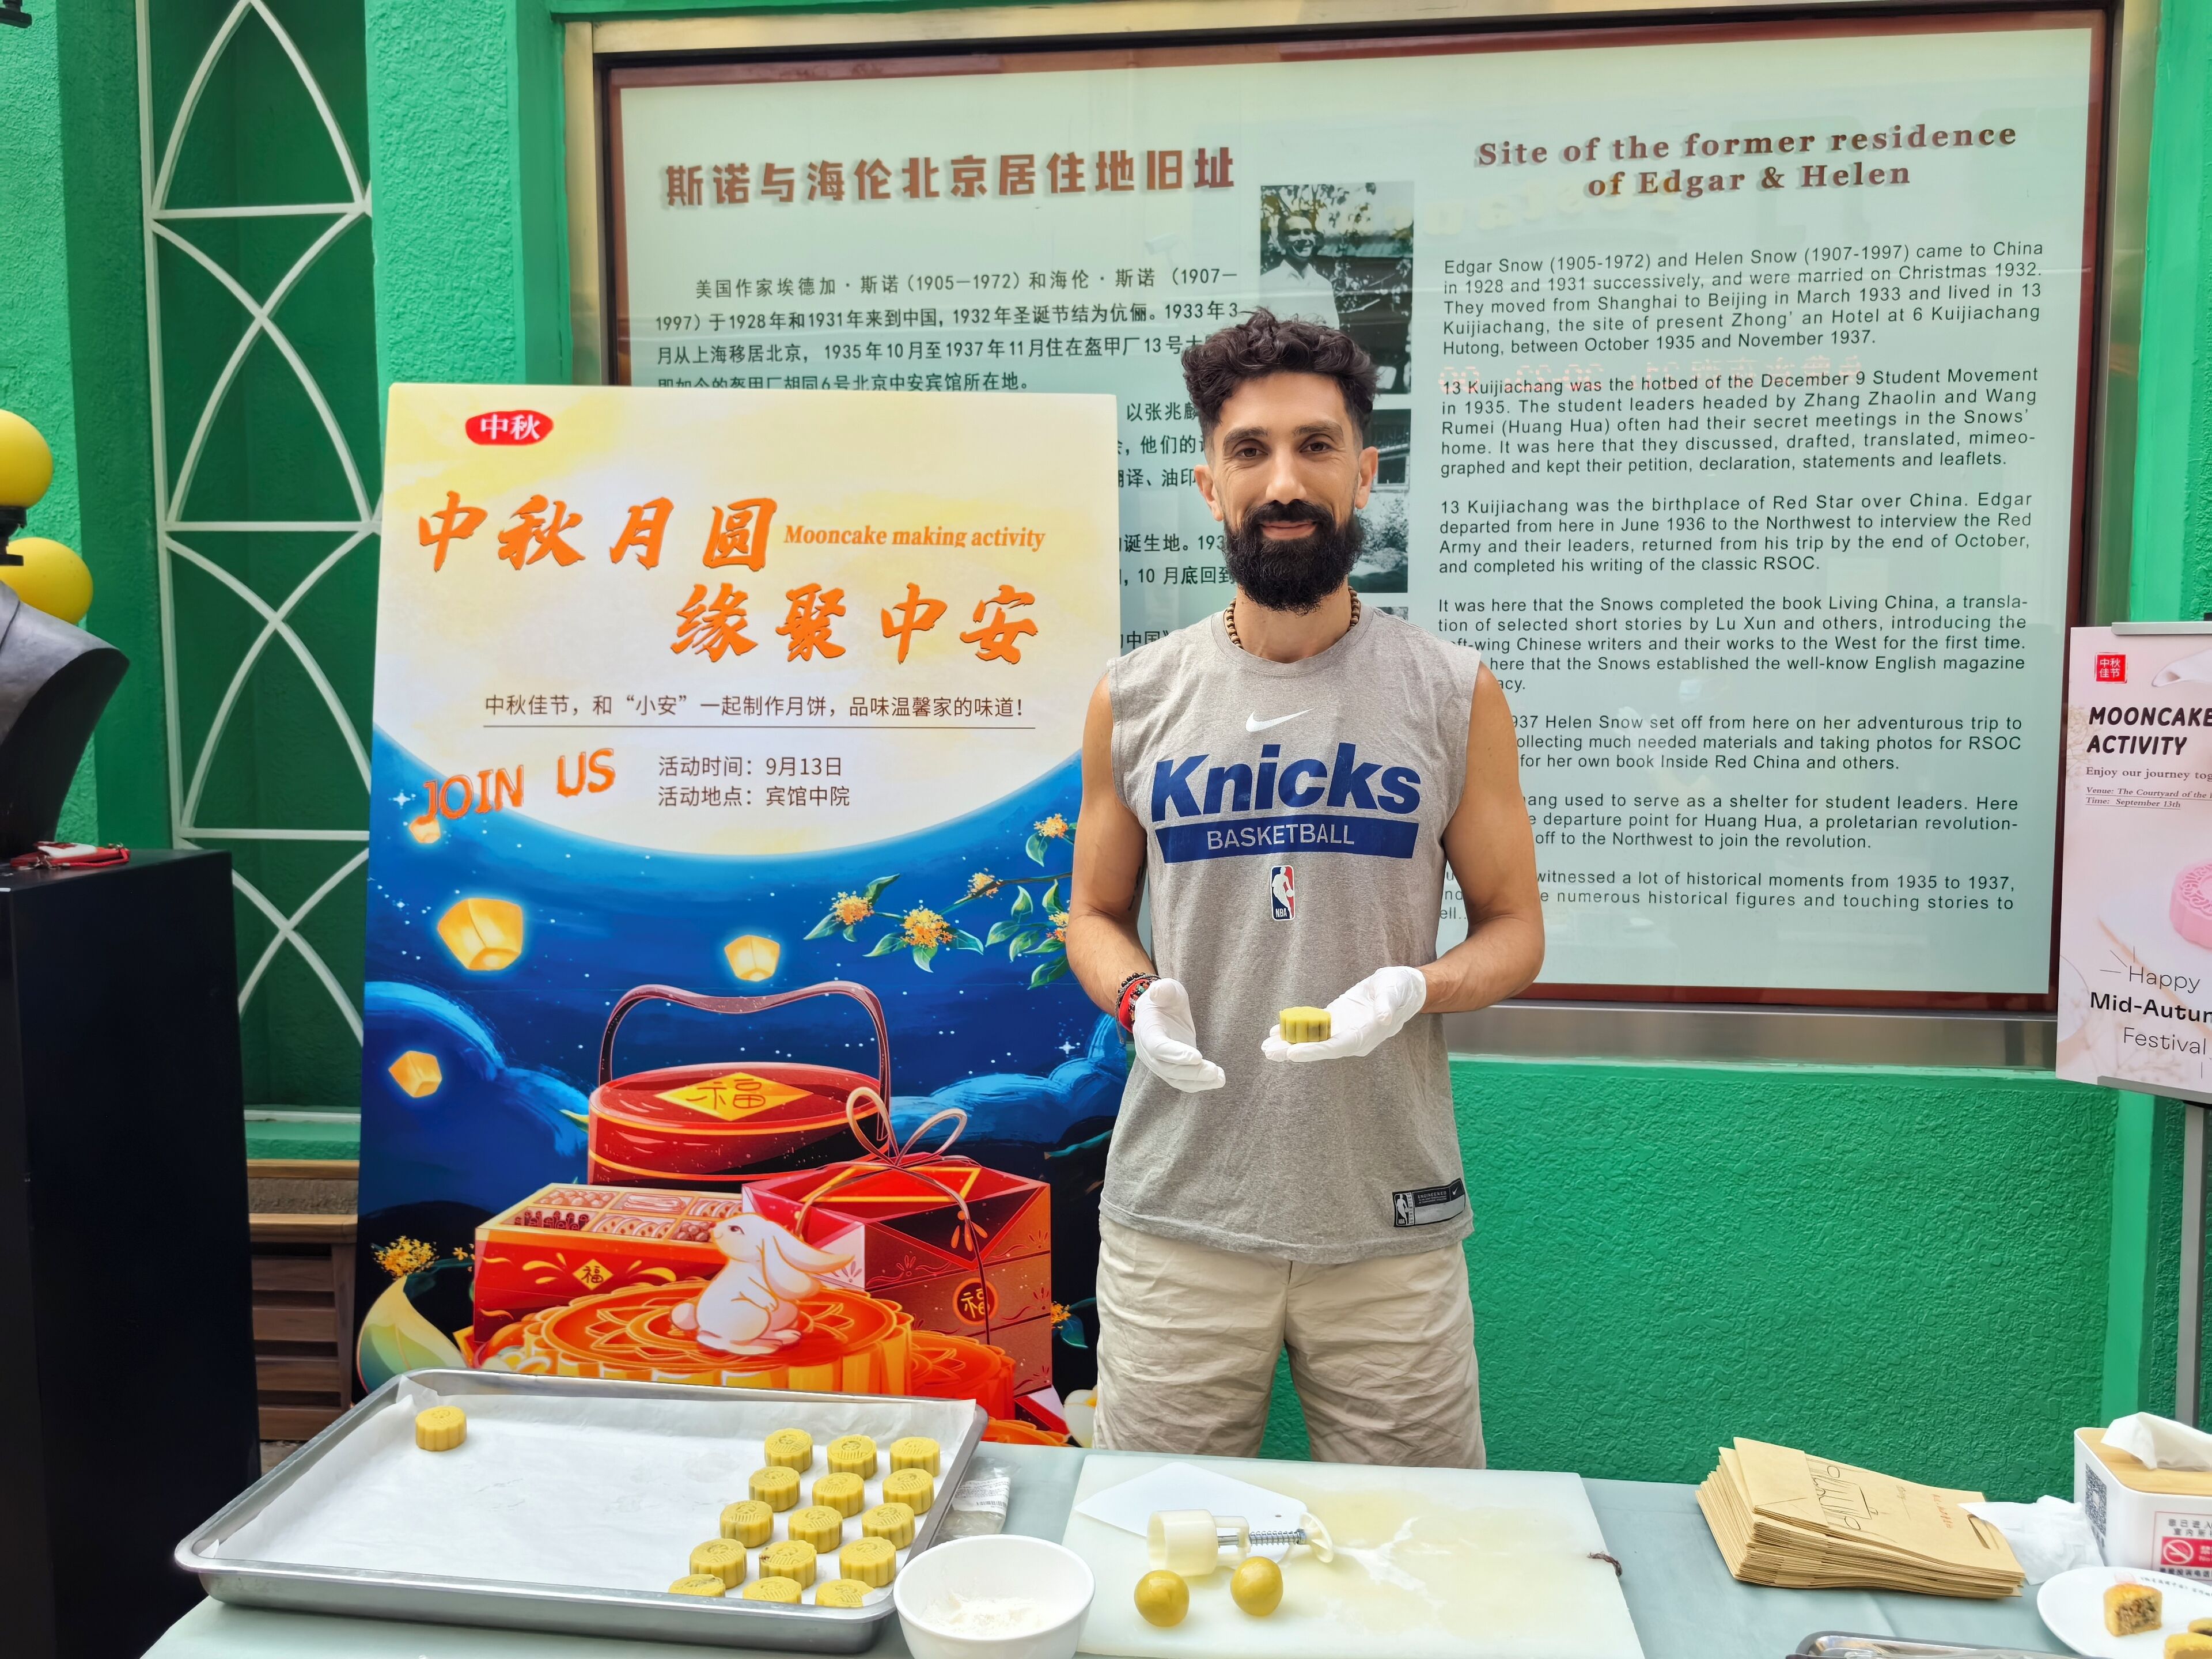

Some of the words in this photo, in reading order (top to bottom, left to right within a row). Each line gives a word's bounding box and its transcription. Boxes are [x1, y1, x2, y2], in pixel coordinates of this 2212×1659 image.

[1478, 141, 1548, 165] Site
[1563, 137, 1600, 161] of
[1612, 135, 1669, 160] the
[1685, 133, 1815, 157] former
[1831, 124, 2016, 151] residence
[666, 147, 1234, 206] 斯诺与海伦北京居住地旧址
[1588, 172, 1625, 196] of
[1638, 169, 1745, 198] Edgar
[1761, 166, 1785, 189] &
[1801, 162, 1910, 187] Helen
[1445, 260, 1492, 276] Edgar
[1499, 259, 1543, 272] Snow
[1551, 253, 1650, 274] (1905-1972)
[1658, 252, 1687, 267] and
[1695, 251, 1743, 266] Helen
[1751, 249, 1797, 264] Snow
[1805, 244, 1908, 266] (1907-1997)
[1916, 247, 1962, 258] came
[1971, 243, 1985, 256] to
[1994, 241, 2042, 256] China
[1444, 320, 1549, 338] Kuijiachang,
[1559, 318, 1584, 331] the
[1593, 317, 1623, 331] site
[1633, 316, 1649, 329] of
[1657, 314, 1723, 332] present
[1802, 314, 1822, 324] an
[1832, 308, 1878, 323] Hotel
[1888, 308, 1904, 321] at
[1914, 307, 1922, 321] 6
[1932, 305, 2039, 323] Kuijiachang
[1444, 381, 1461, 395] 13
[1468, 380, 1562, 397] Kuijiachang
[1570, 381, 1601, 392] was
[1609, 377, 1633, 391] the
[1642, 376, 1698, 391] hotbed
[1706, 375, 1722, 389] of
[1728, 375, 1753, 388] the
[1762, 372, 1849, 387] December
[1856, 371, 1865, 385] 9
[1873, 370, 1940, 384] Student
[1948, 368, 2037, 382] Movement
[480, 414, 540, 442] 中秋
[1442, 441, 1491, 454] home.
[1501, 441, 1509, 453] It
[1517, 443, 1549, 453] was
[1558, 440, 1594, 452] here
[1603, 438, 1634, 452] that
[1642, 438, 1677, 454] they
[1686, 435, 1778, 450] discussed,
[1787, 433, 1855, 449] drafted,
[1864, 431, 1960, 446] translated,
[1969, 430, 2035, 444] mimeo-
[1442, 501, 1459, 514] 13
[1468, 499, 1567, 517] Kuijiachang
[1577, 502, 1609, 512] was
[1618, 498, 1643, 512] the
[1653, 497, 1740, 513] birthplace
[1748, 495, 1765, 510] of
[1774, 495, 1807, 509] Red
[1816, 495, 1853, 509] Star
[1862, 497, 1901, 508] over
[1910, 493, 1967, 507] China.
[1978, 492, 2032, 509] Edgar
[418, 490, 778, 573] 中秋月圆
[783, 525, 887, 545] Mooncake
[892, 527, 967, 548] making
[971, 527, 1046, 552] activity
[1119, 533, 1224, 552] 诞生地。193
[671, 582, 1039, 665] 缘聚中安
[1438, 619, 1467, 631] tion
[1476, 618, 1491, 631] of
[1498, 618, 1567, 631] selected
[1575, 618, 1617, 631] short
[1626, 617, 1681, 630] stories
[1690, 617, 1709, 634] by
[1717, 616, 1735, 630] Lu
[1744, 616, 1775, 630] Xun
[1784, 616, 1814, 630] and
[1823, 616, 1883, 631] others,
[1892, 615, 1990, 632] introducing
[1999, 615, 2026, 628] the
[1490, 657, 1524, 670] here
[1531, 657, 1560, 670] that
[1567, 657, 1591, 670] the
[1598, 657, 1650, 670] Snows
[1657, 657, 1748, 670] established
[1756, 657, 1780, 669] the
[1787, 656, 1868, 669] well-know
[1876, 656, 1936, 673] English
[1944, 656, 2024, 673] magazine
[2100, 658, 2121, 668] 中秋
[2100, 668, 2120, 678] 佳节
[2089, 706, 2212, 727] MOONCAKE
[1517, 735, 1582, 751] ollecting
[1589, 735, 1630, 748] much
[1638, 735, 1696, 748] needed
[1703, 735, 1777, 749] materials
[1784, 736, 1813, 749] and
[1820, 736, 1869, 752] taking
[1877, 736, 1932, 752] photos
[1940, 736, 1962, 749] for
[1969, 736, 2021, 749] RSOC
[2086, 734, 2187, 755] ACTIVITY
[658, 755, 843, 778] 活动时间：9月13日
[2086, 767, 2118, 778] Enjoy
[2144, 768, 2190, 781] journey
[416, 764, 524, 825] JOIN
[556, 747, 616, 798] US
[1152, 742, 1421, 822] Knicks
[2136, 789, 2179, 798] Courtyard
[658, 785, 850, 808] 活动地点：宾馆中院
[2116, 798, 2160, 808] September
[1207, 824, 1354, 850] BASKETBALL
[1536, 831, 1555, 844] off
[1561, 832, 1575, 844] to
[1582, 832, 1605, 844] the
[1613, 832, 1692, 846] Northwest
[1699, 834, 1713, 846] to
[1719, 833, 1747, 850] join
[1755, 834, 1779, 847] the
[1786, 834, 1870, 848] revolution.
[1275, 908, 1287, 918] NBA
[2129, 965, 2200, 993] Happy
[2124, 1027, 2206, 1055] Festival
[687, 1081, 766, 1111] 福
[1418, 1191, 1447, 1199] ENGINEERED
[582, 1265, 604, 1285] 福
[961, 1289, 991, 1317] 福
